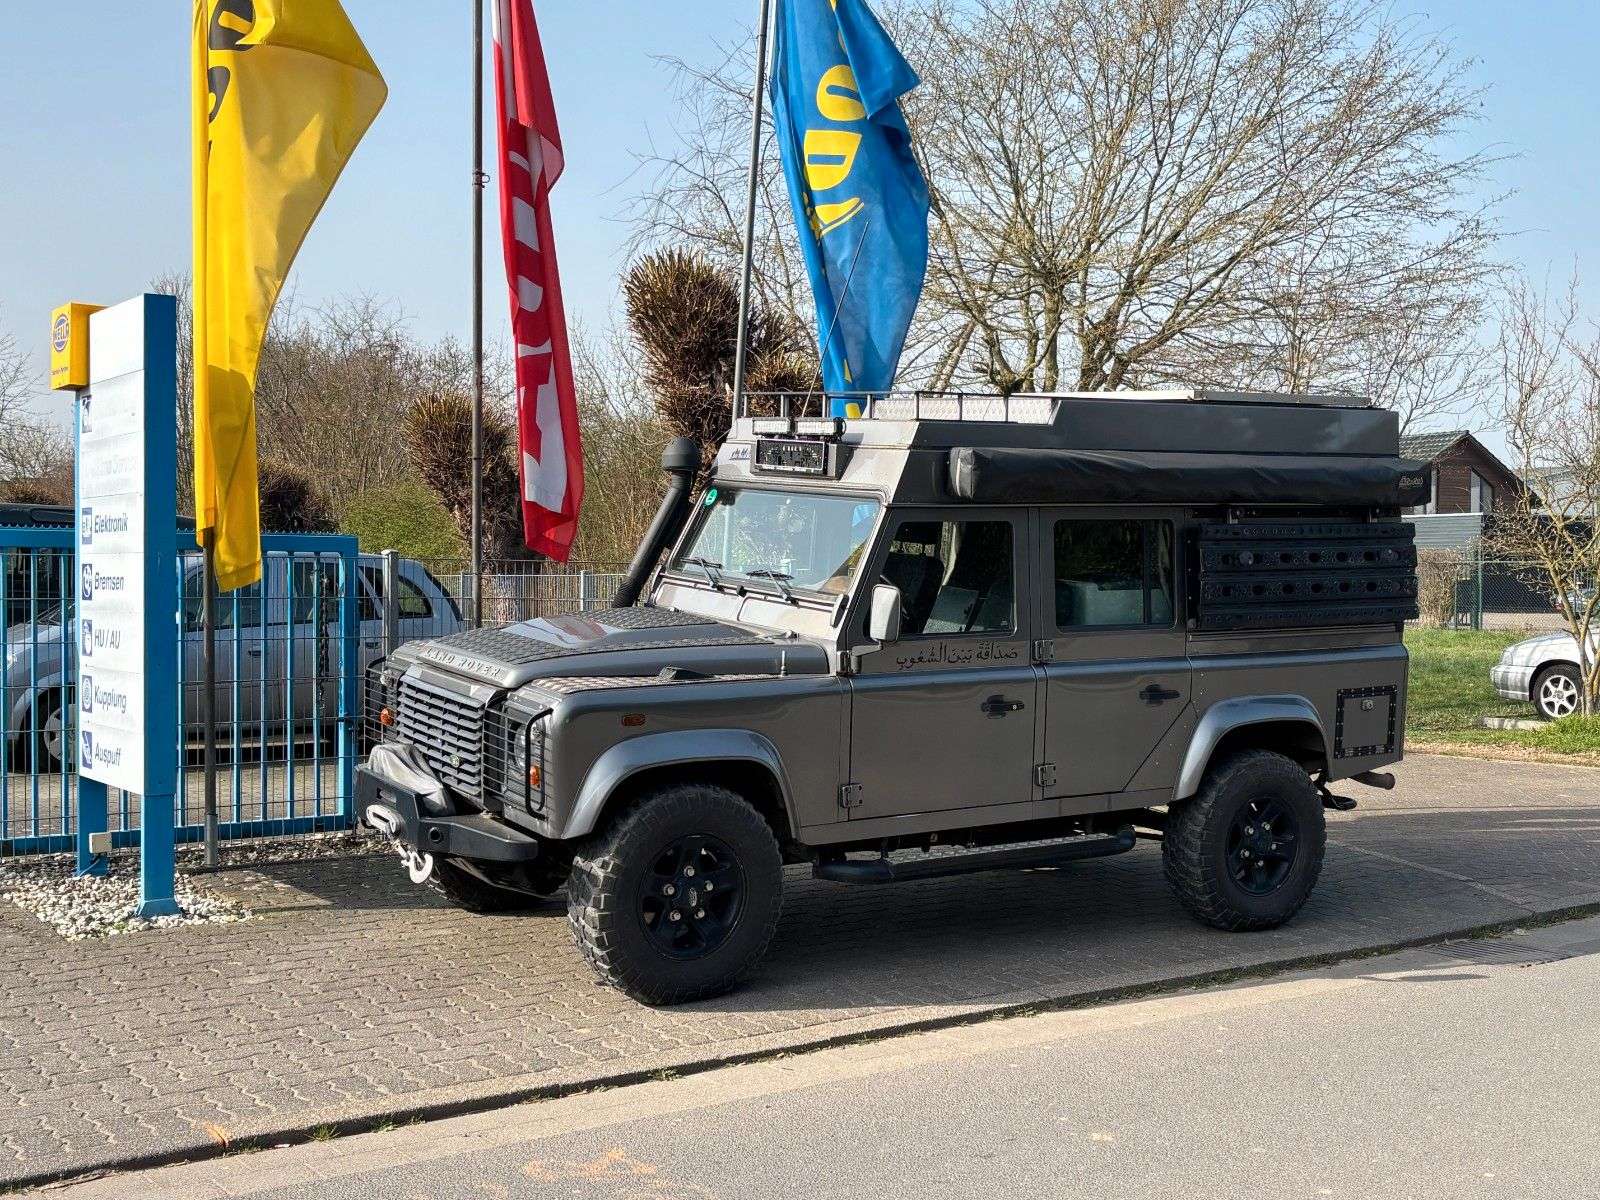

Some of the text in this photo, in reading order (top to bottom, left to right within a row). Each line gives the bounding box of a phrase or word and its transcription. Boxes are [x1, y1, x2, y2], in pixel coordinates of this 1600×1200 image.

[95, 512, 128, 534] Elektronik
[94, 572, 125, 591] Bremsen
[94, 628, 105, 648] HU
[110, 630, 121, 650] AU
[427, 647, 502, 677] LAND ROVER
[94, 684, 127, 714] Kupplung
[94, 742, 122, 768] Auspuff
